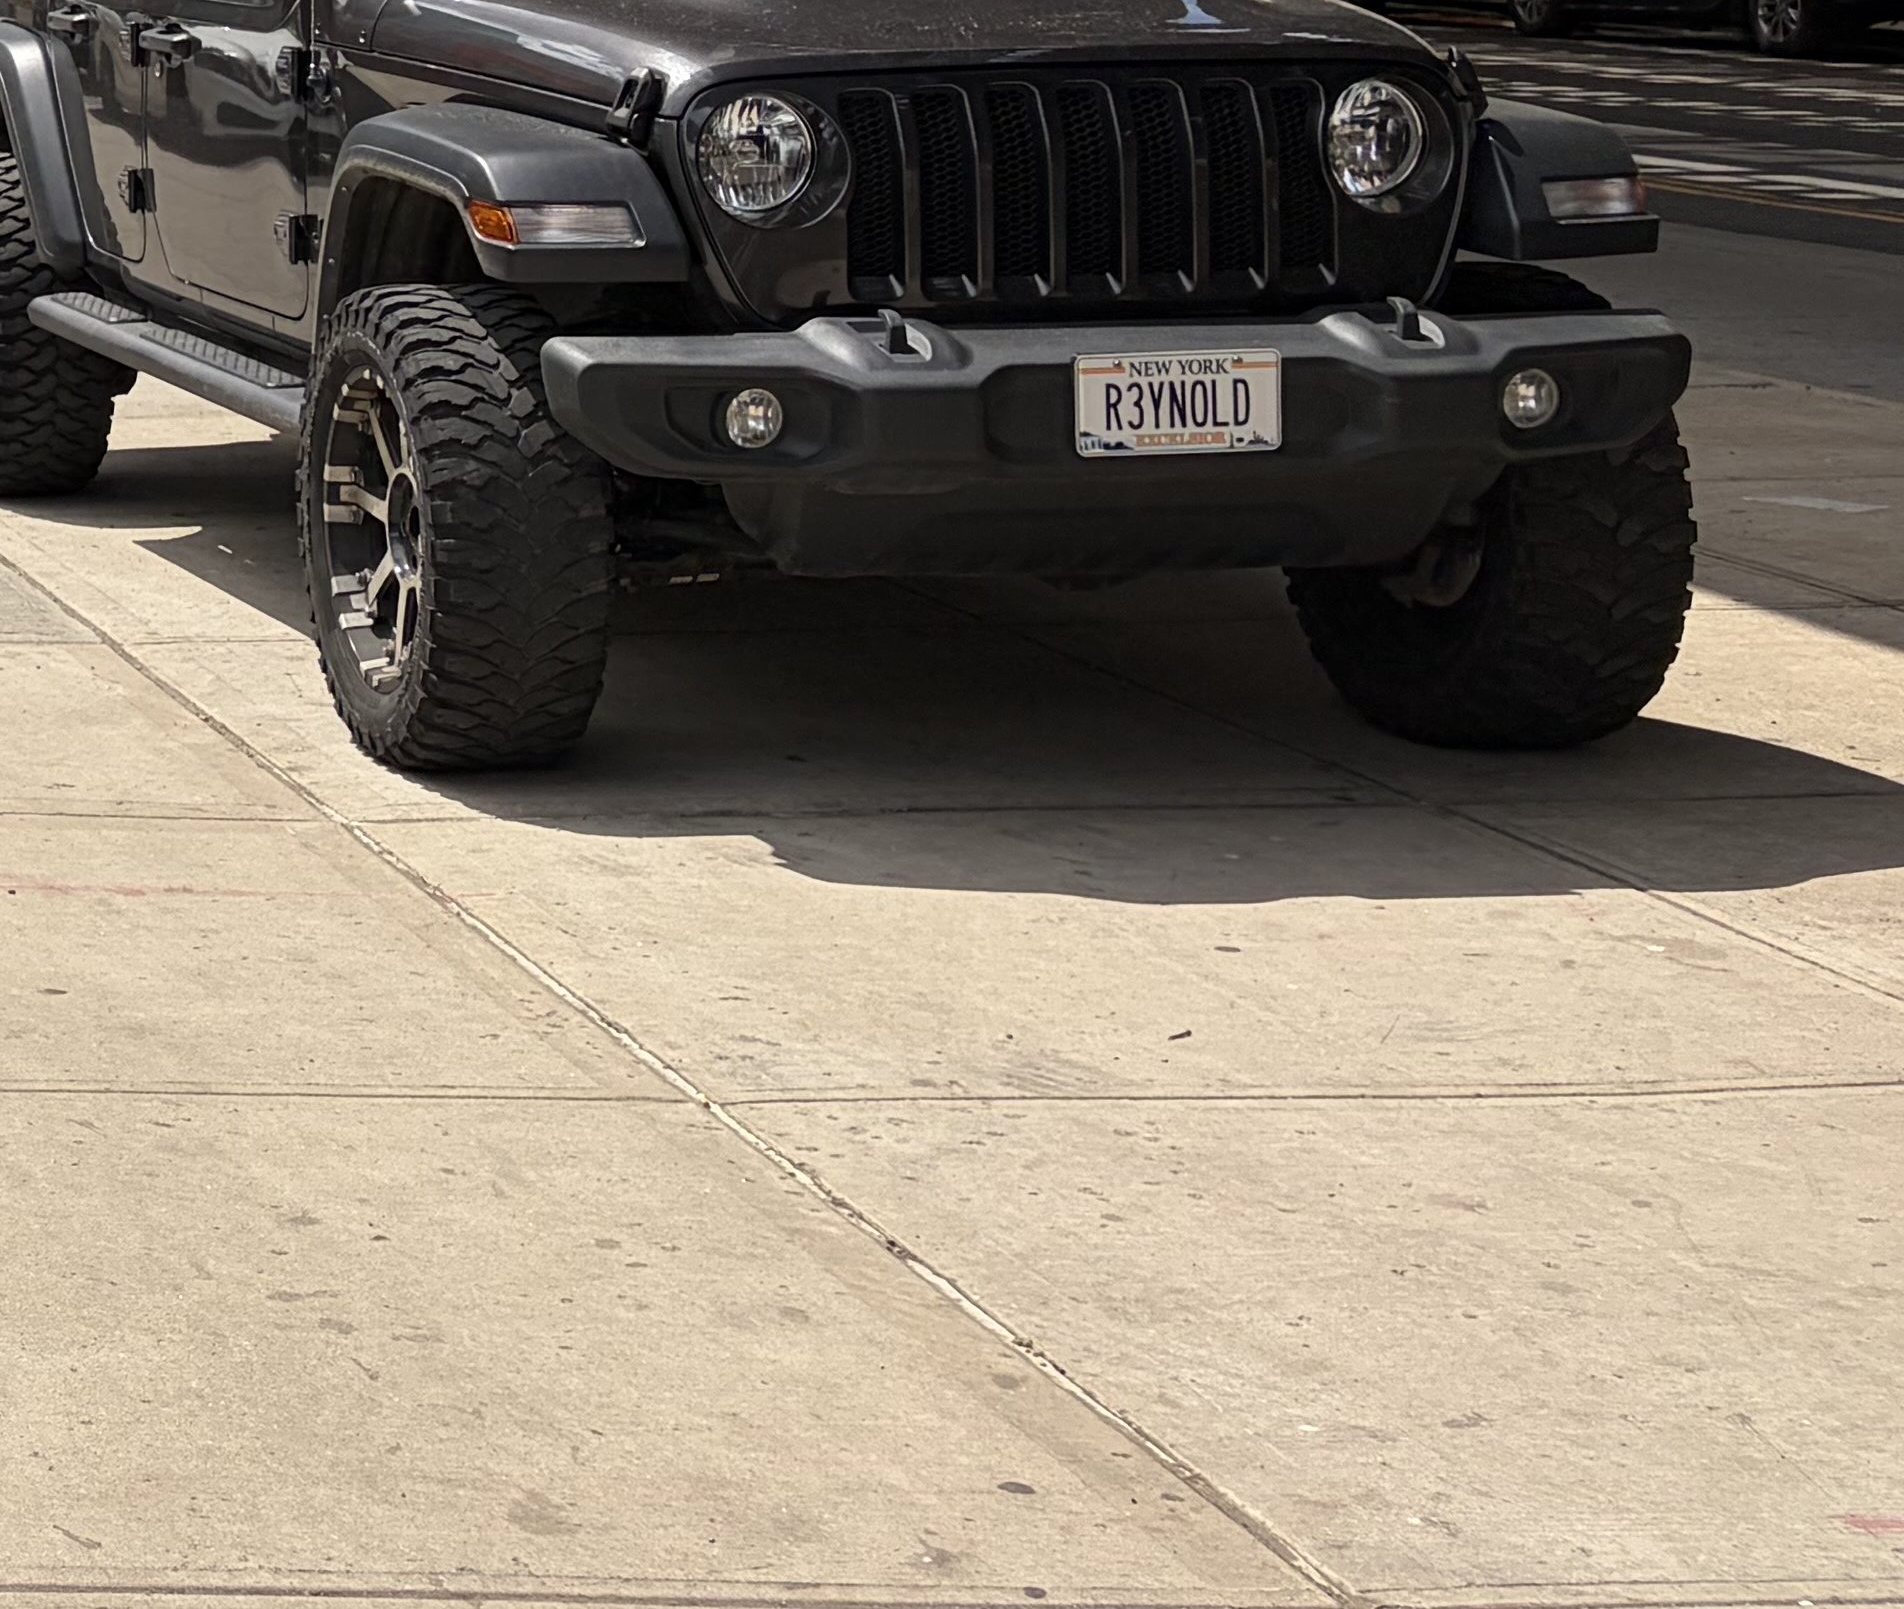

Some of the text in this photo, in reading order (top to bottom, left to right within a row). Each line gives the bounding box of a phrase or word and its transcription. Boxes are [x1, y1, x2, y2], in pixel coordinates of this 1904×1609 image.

[1128, 357, 1231, 378] NEW YORK
[1105, 378, 1252, 432] R3YNOLD
